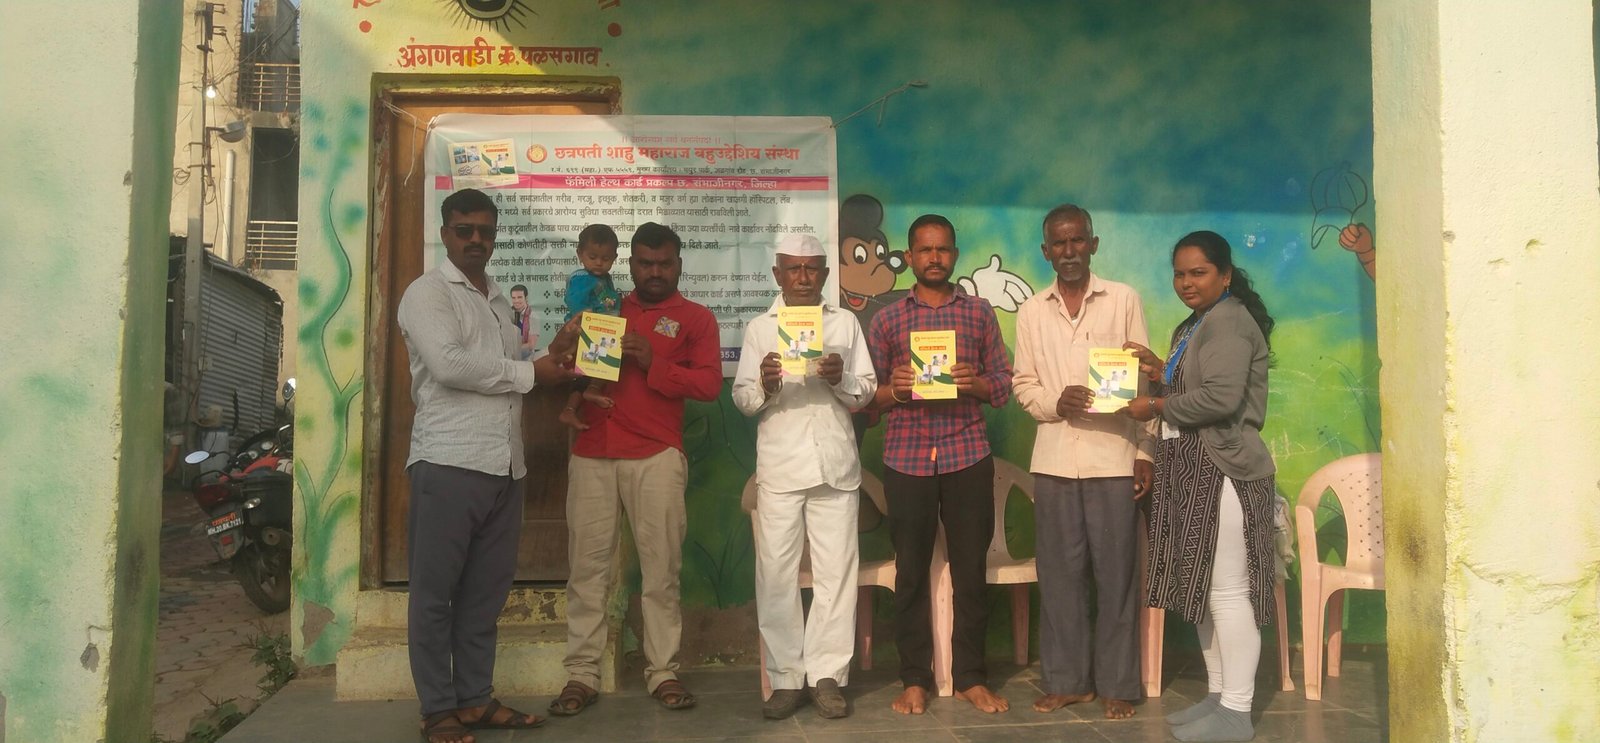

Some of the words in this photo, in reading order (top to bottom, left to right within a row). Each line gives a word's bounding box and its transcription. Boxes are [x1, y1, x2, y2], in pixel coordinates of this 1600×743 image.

[398, 36, 496, 68] अंगणवाडी
[555, 144, 603, 159] छत्रपती
[606, 146, 635, 164] शाहु
[638, 147, 691, 161] महाराज
[765, 145, 800, 161] संस्था
[600, 176, 620, 188] हेल्थ
[624, 175, 643, 188] कार्ड
[646, 178, 673, 188] प्रकल्प
[751, 178, 777, 189] जिल्हा
[496, 193, 503, 203] ही
[506, 192, 516, 202] सर्व
[520, 193, 553, 202] समाजातील
[678, 193, 687, 203] वर्ग
[505, 207, 518, 215] मध्ये
[522, 206, 531, 215] सर्व
[533, 207, 553, 215] प्रकारचे
[554, 207, 577, 215] आरोग्य
[579, 206, 599, 218] सुविधा
[602, 206, 634, 215] सवलतीच्या
[686, 207, 708, 216] यासाठी
[539, 222, 556, 232] केवळ
[790, 224, 816, 233] असतील.
[517, 239, 547, 250] कोणतीही
[689, 239, 702, 249] दिले
[490, 257, 510, 266] प्रत्येक
[547, 256, 578, 266] घेण्यासाठी
[496, 272, 509, 282] कार्ड
[710, 287, 724, 297] कार्ड
[743, 289, 770, 297] आवश्यक
